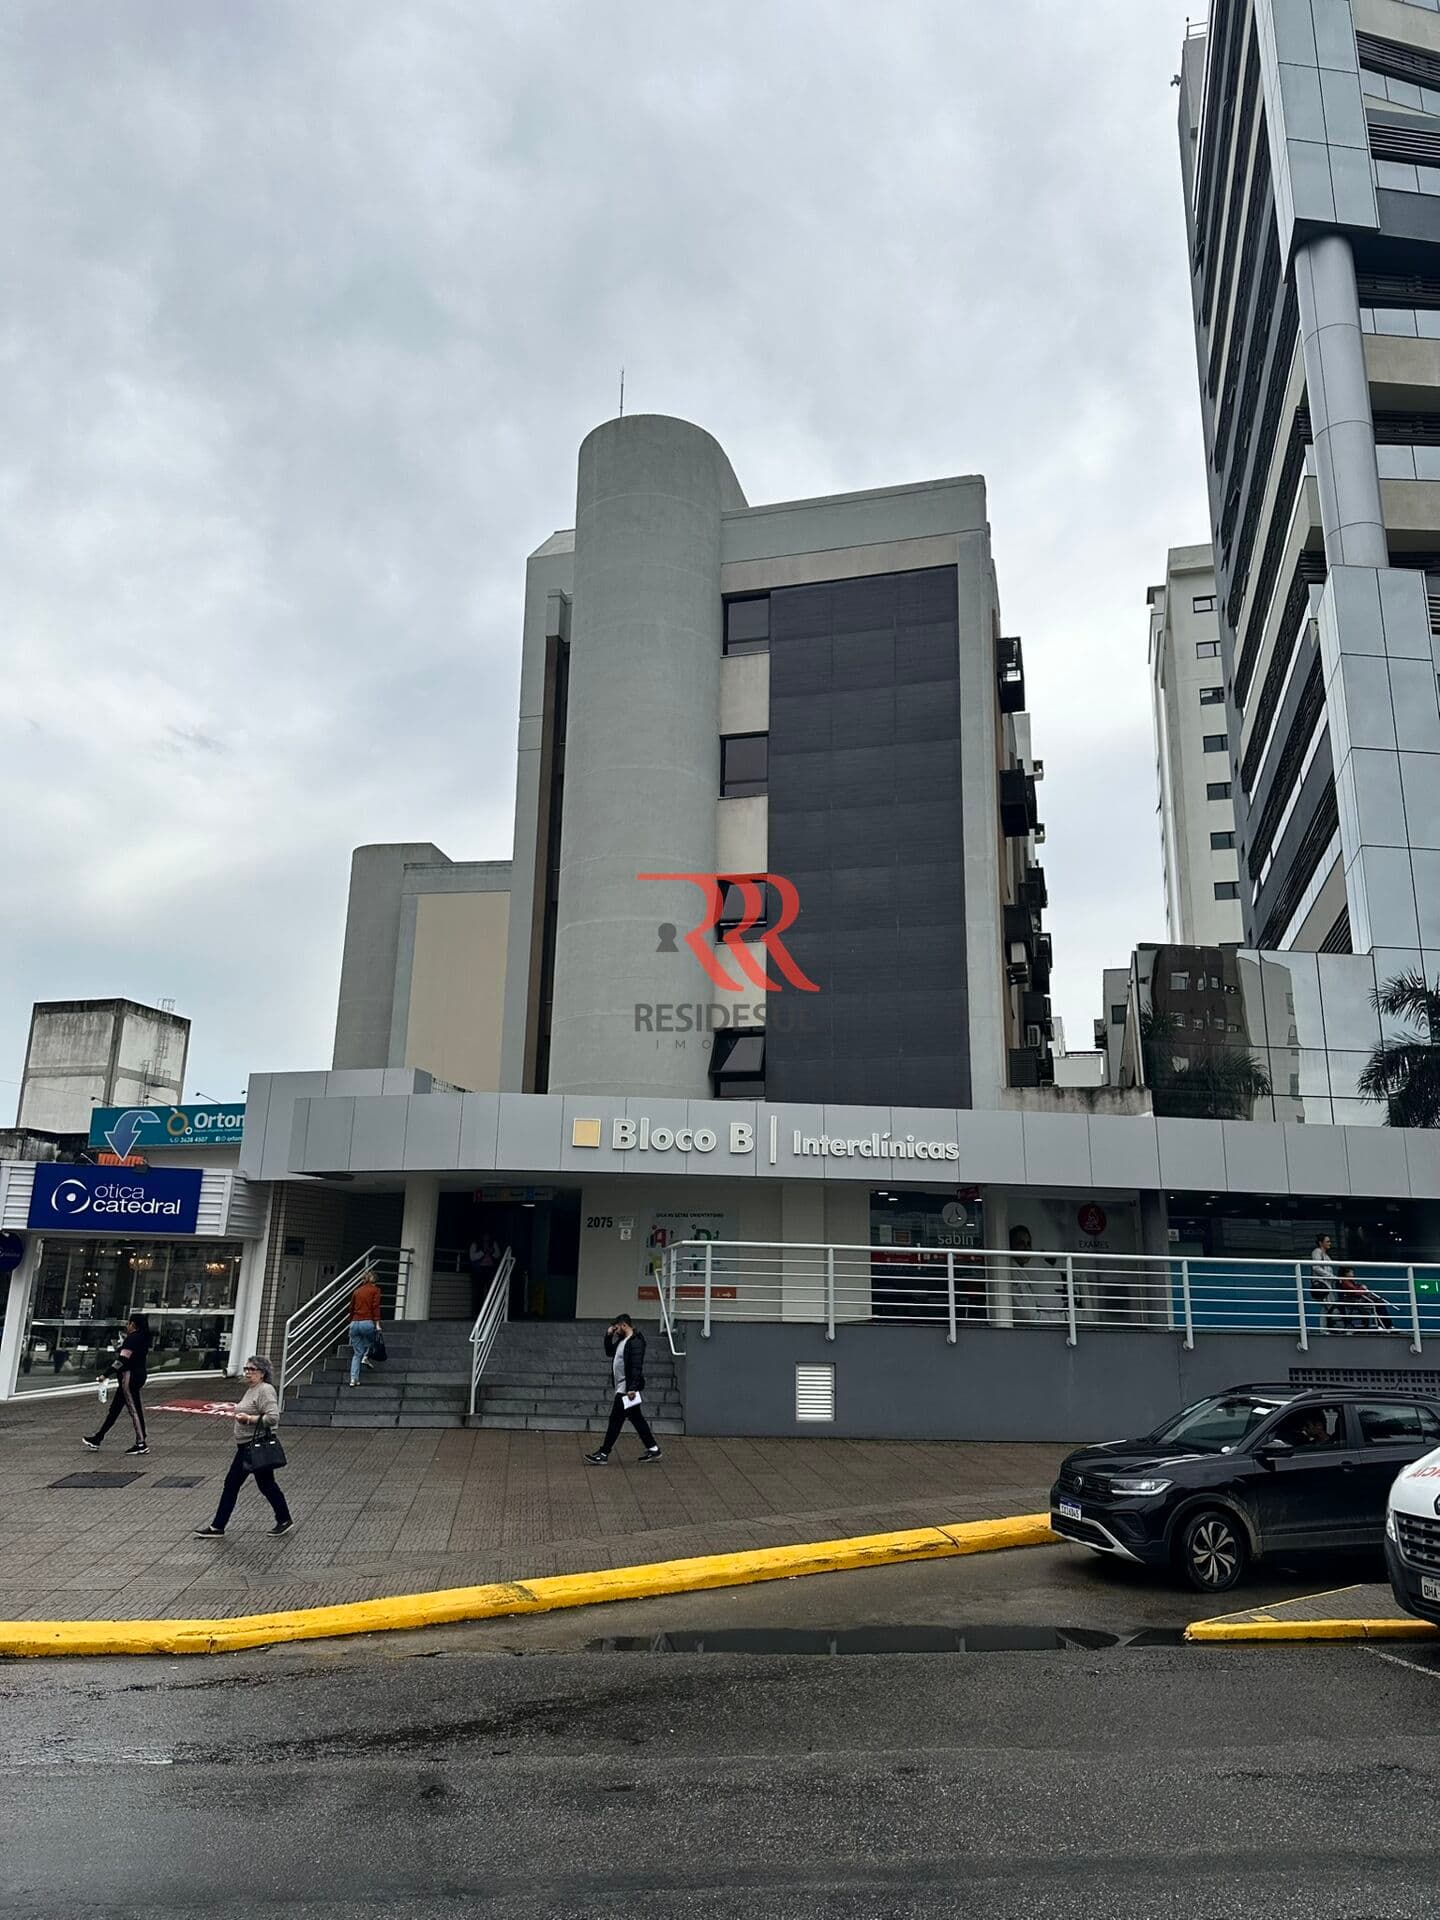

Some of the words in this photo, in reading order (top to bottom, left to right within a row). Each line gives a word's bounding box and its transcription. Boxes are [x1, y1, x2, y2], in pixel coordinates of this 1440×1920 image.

[612, 1118, 717, 1153] Bloco
[729, 1121, 754, 1154] B
[792, 1129, 961, 1161] Interclínicas
[93, 1198, 181, 1215] catedral
[587, 1216, 613, 1228] 2075
[937, 1231, 974, 1246] sabin
[1079, 1239, 1111, 1249] EXAMES
